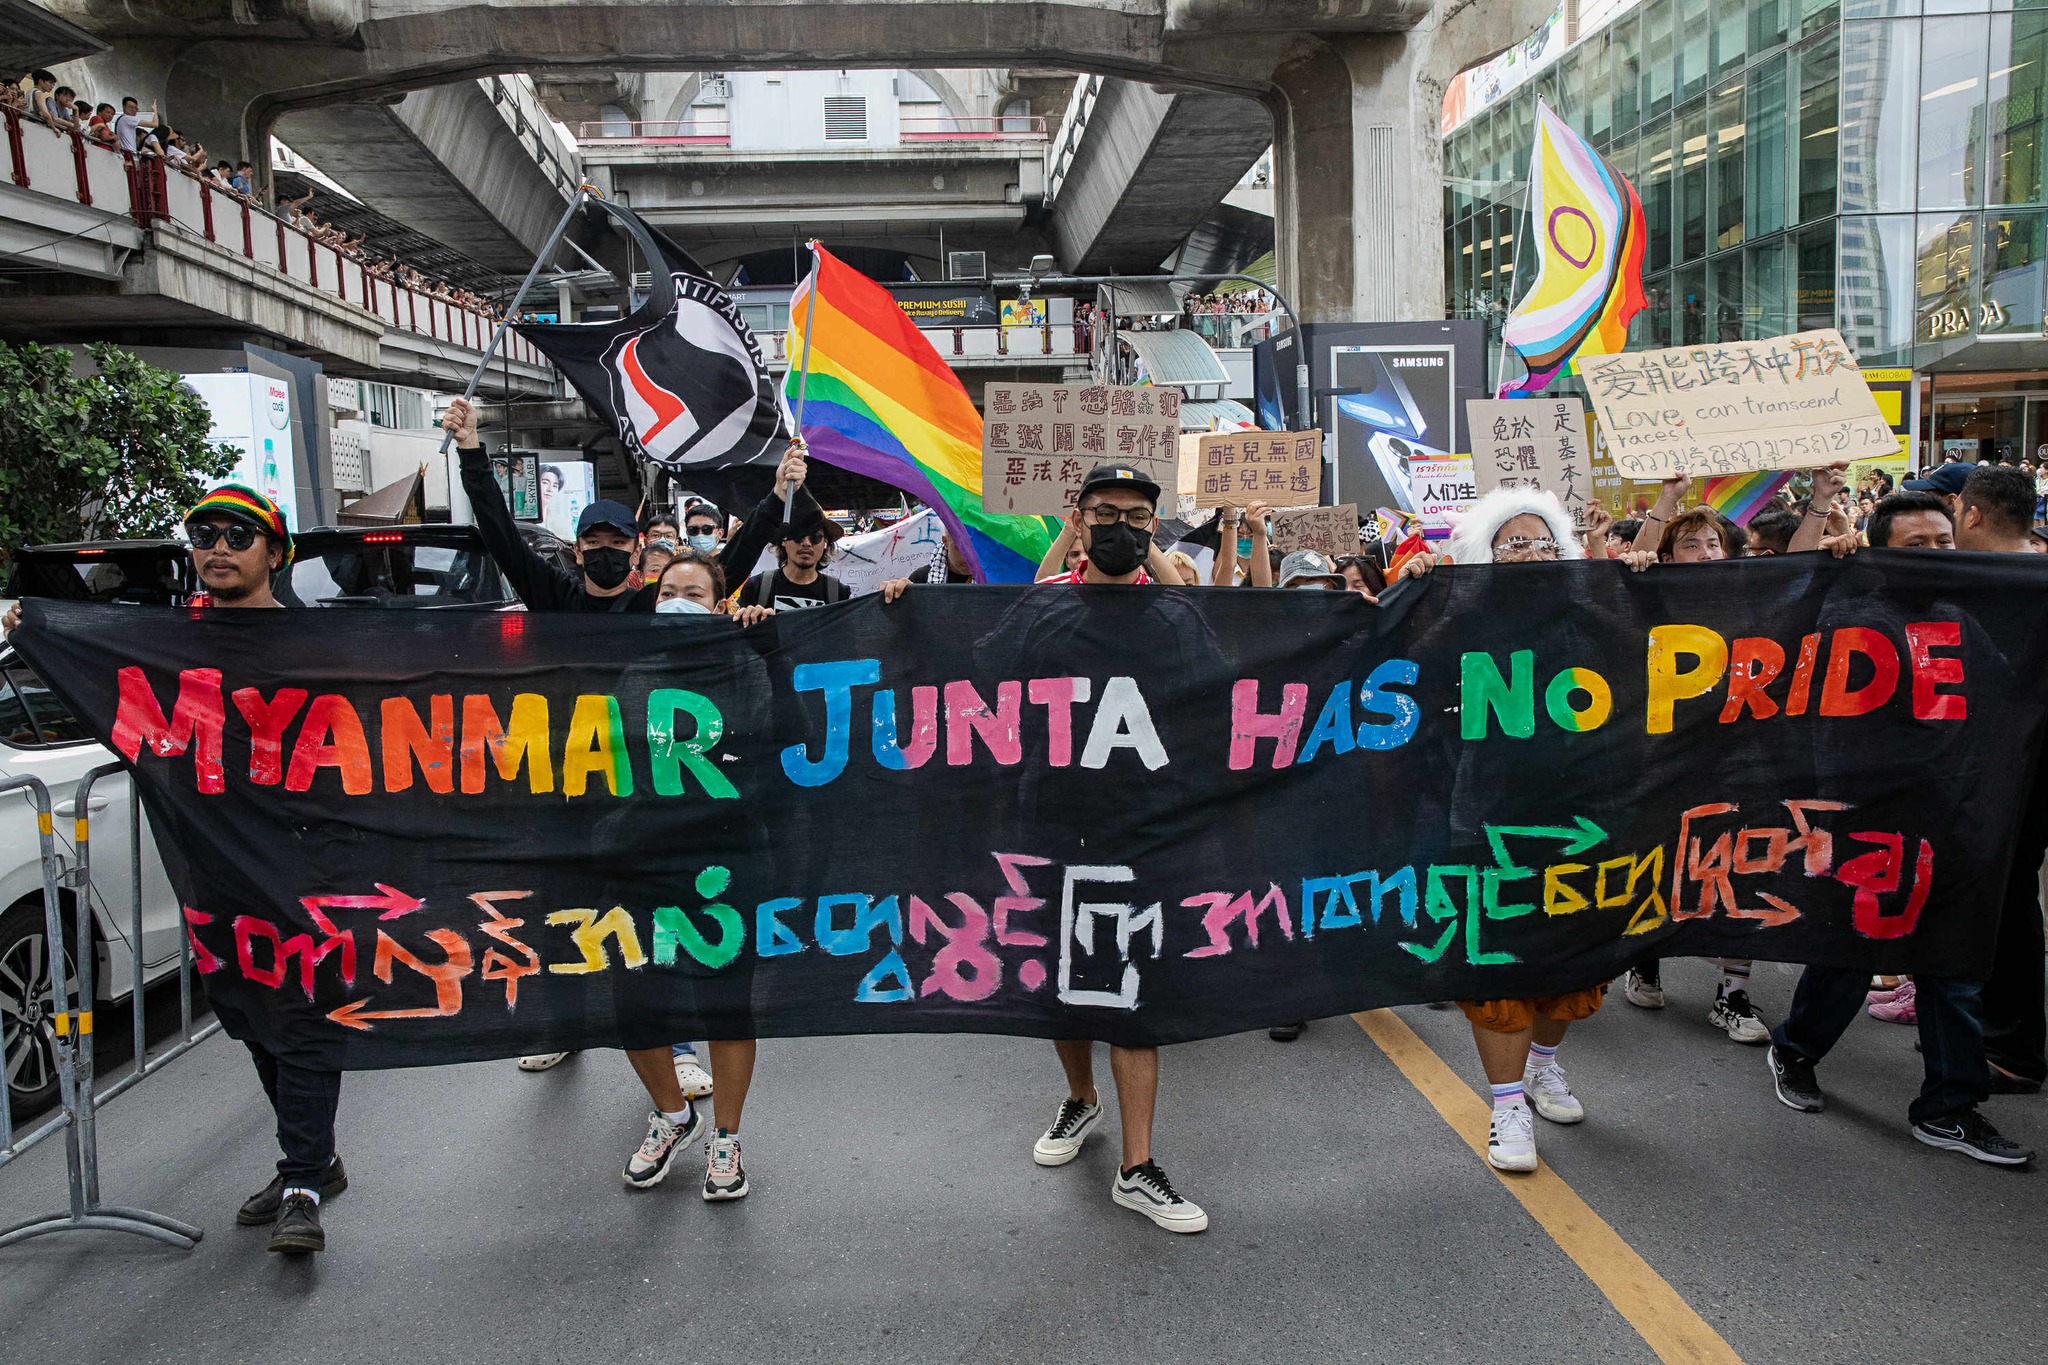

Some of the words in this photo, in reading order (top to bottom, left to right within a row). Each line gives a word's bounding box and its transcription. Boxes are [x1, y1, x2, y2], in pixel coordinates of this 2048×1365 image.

[897, 300, 940, 310] PREMIUM
[942, 299, 967, 309] SUSHI
[1928, 300, 2003, 338] PRADA
[1276, 336, 1292, 351] SAMSUNG
[1392, 357, 1444, 368] SAMSUNG
[1592, 338, 1859, 400] 爱能跨种族
[1880, 371, 1908, 379] GLOBAL
[268, 386, 286, 399] Malee
[1696, 403, 1739, 421] can
[1743, 388, 1843, 415] transcend
[1208, 437, 1315, 466] 酷兒無國
[527, 459, 537, 504] SKYNLAB+
[1205, 465, 1316, 493] 酷兒無邊
[1595, 478, 1607, 487] NEW
[112, 666, 740, 799] MYANMAR
[779, 658, 1169, 787] JUNTA
[1228, 659, 1420, 771] HAS
[1646, 621, 1967, 735] PRIDE
